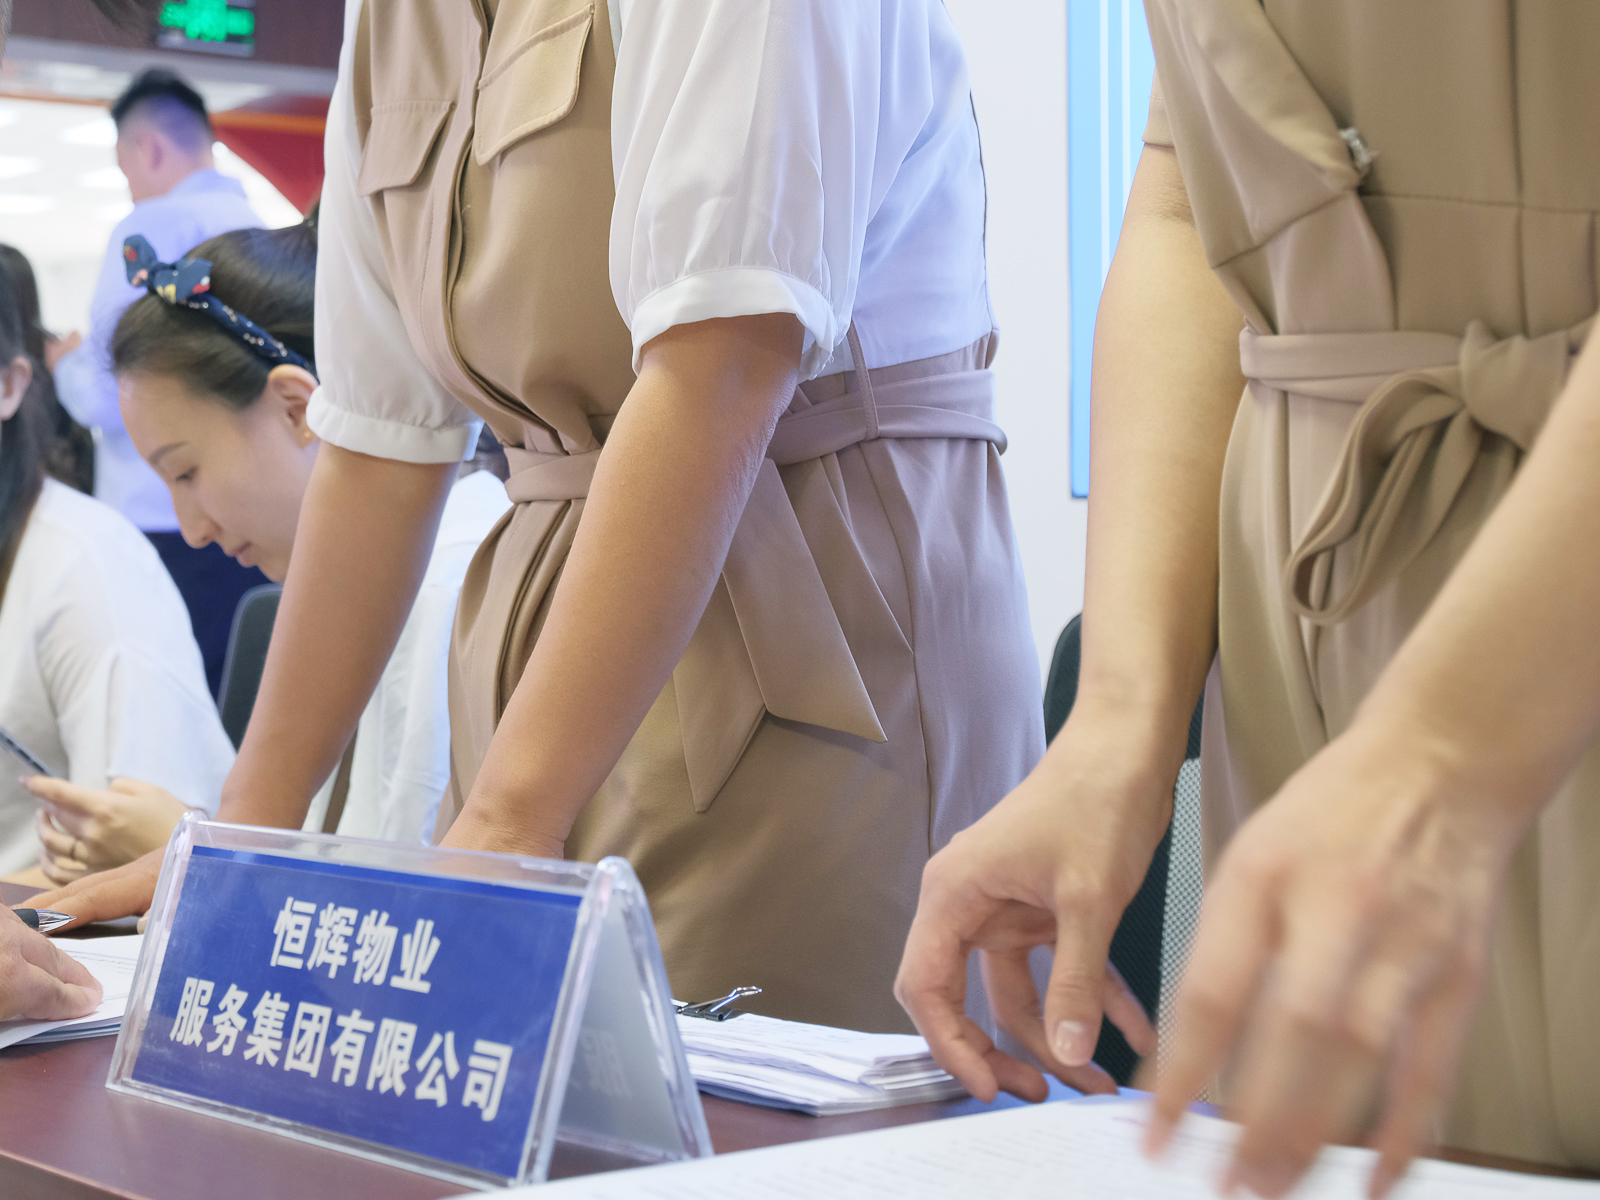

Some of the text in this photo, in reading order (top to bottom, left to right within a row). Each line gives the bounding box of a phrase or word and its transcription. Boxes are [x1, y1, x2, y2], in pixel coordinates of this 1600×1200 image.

[269, 896, 441, 994] 恒辉物业
[170, 976, 513, 1122] 服务集团有限公司
